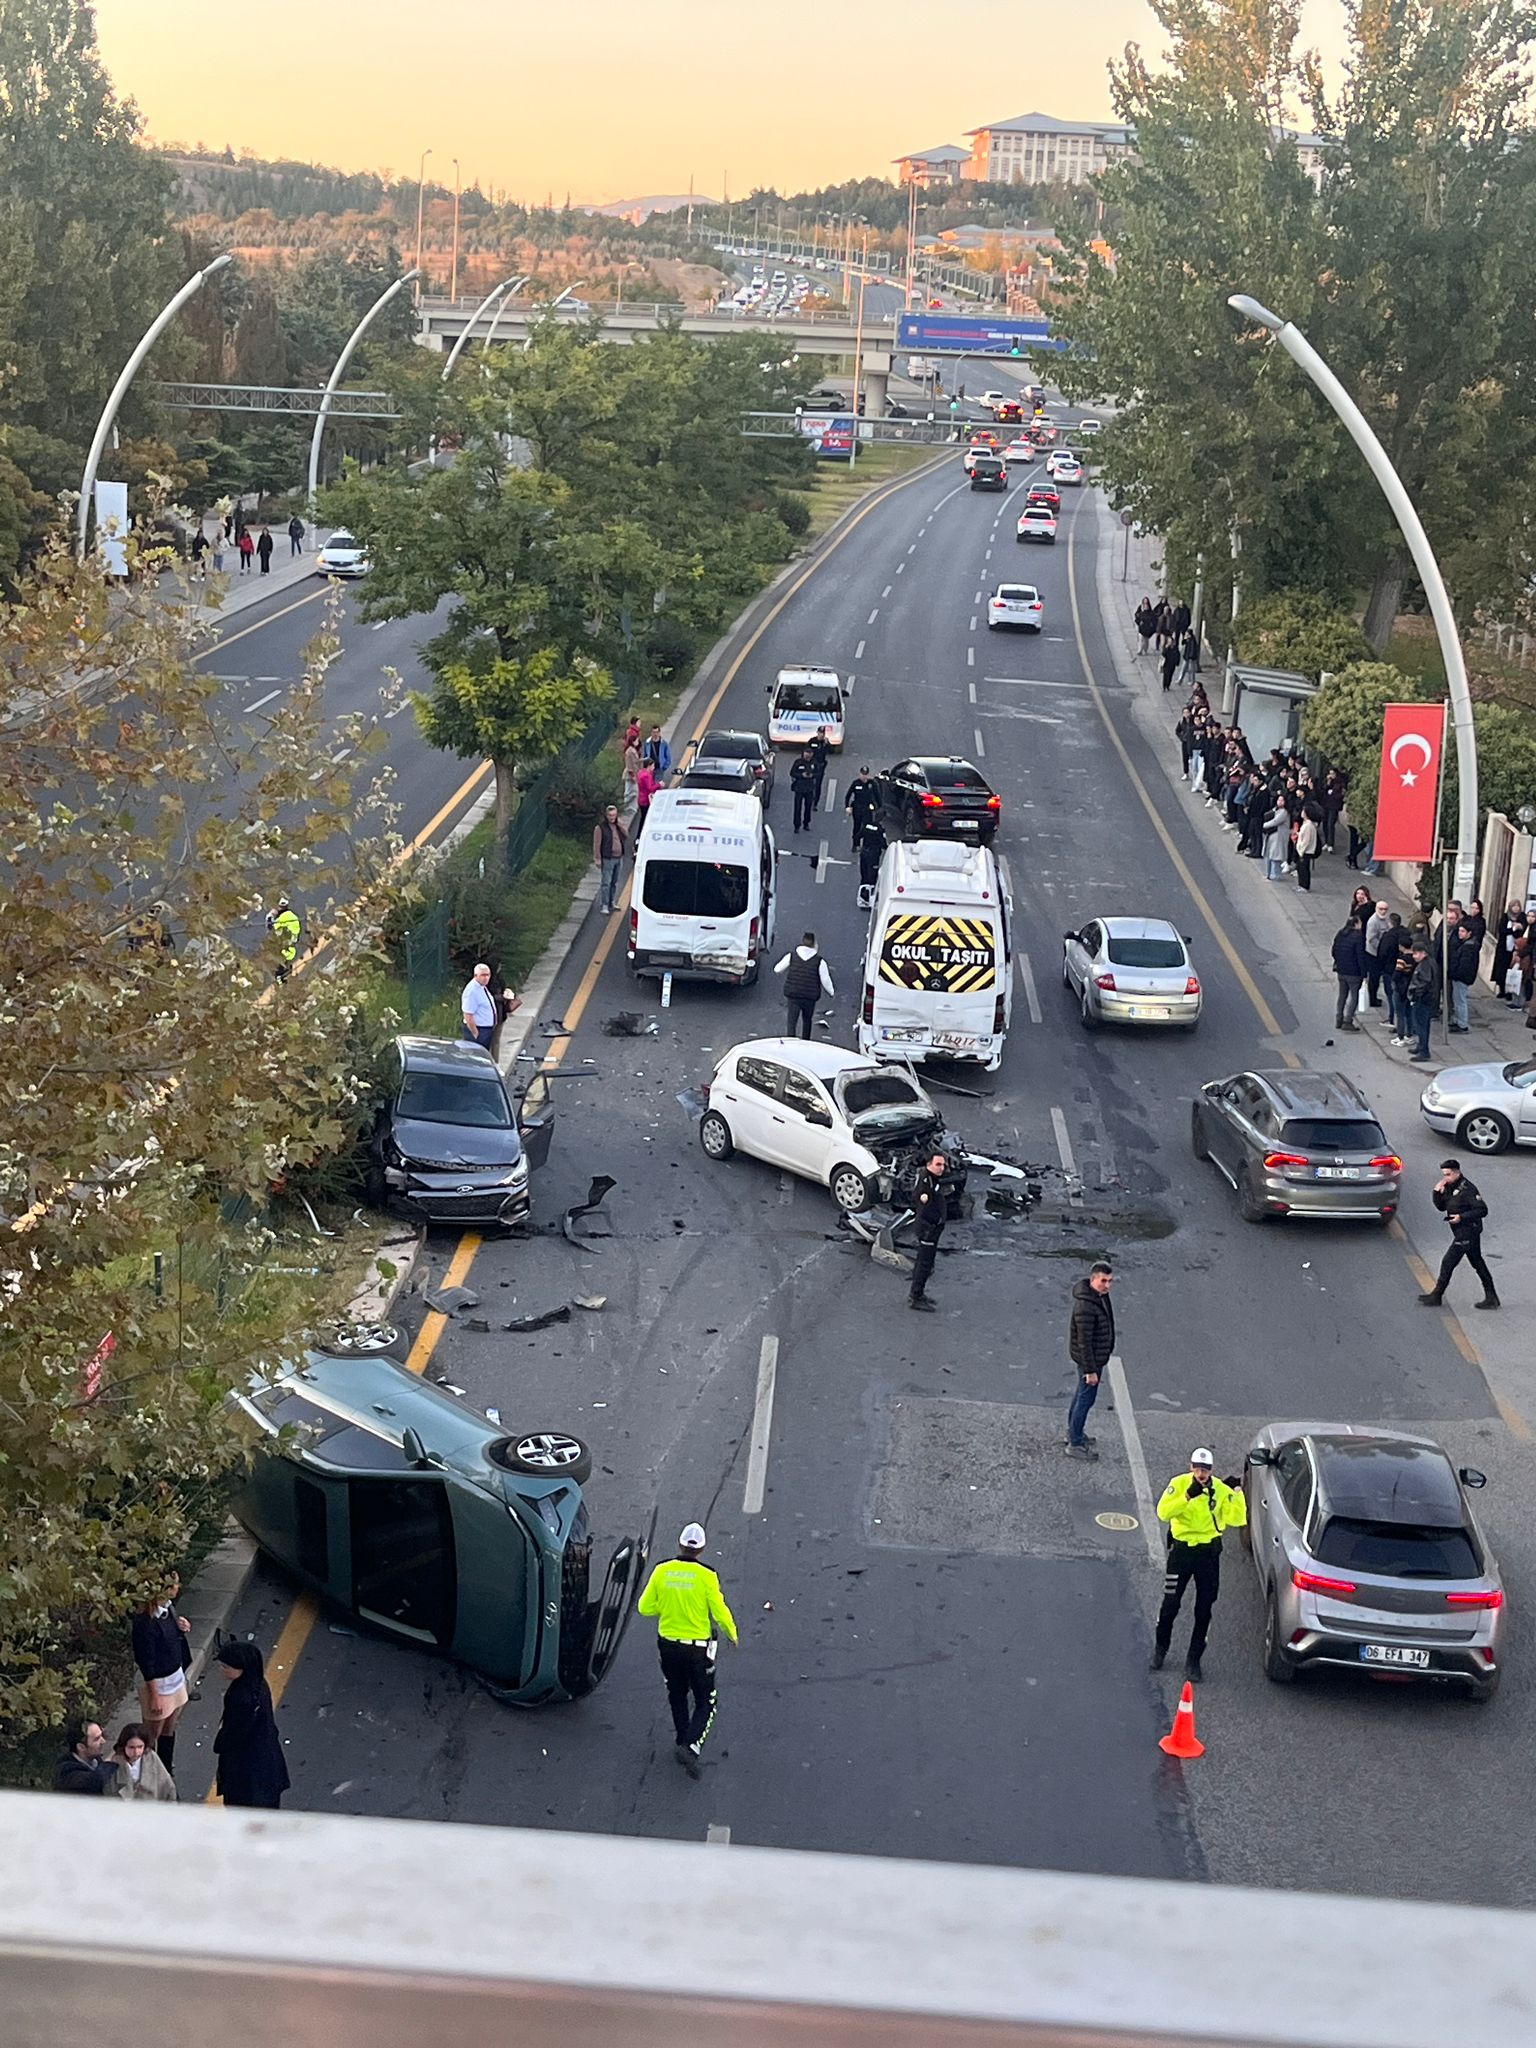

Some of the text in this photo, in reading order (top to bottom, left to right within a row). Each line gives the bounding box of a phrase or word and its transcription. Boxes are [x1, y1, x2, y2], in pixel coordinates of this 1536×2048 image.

[713, 836, 744, 846] TUR
[891, 944, 989, 966] OKUL TAŞITI
[1366, 1646, 1428, 1662] 06 EFA 347
